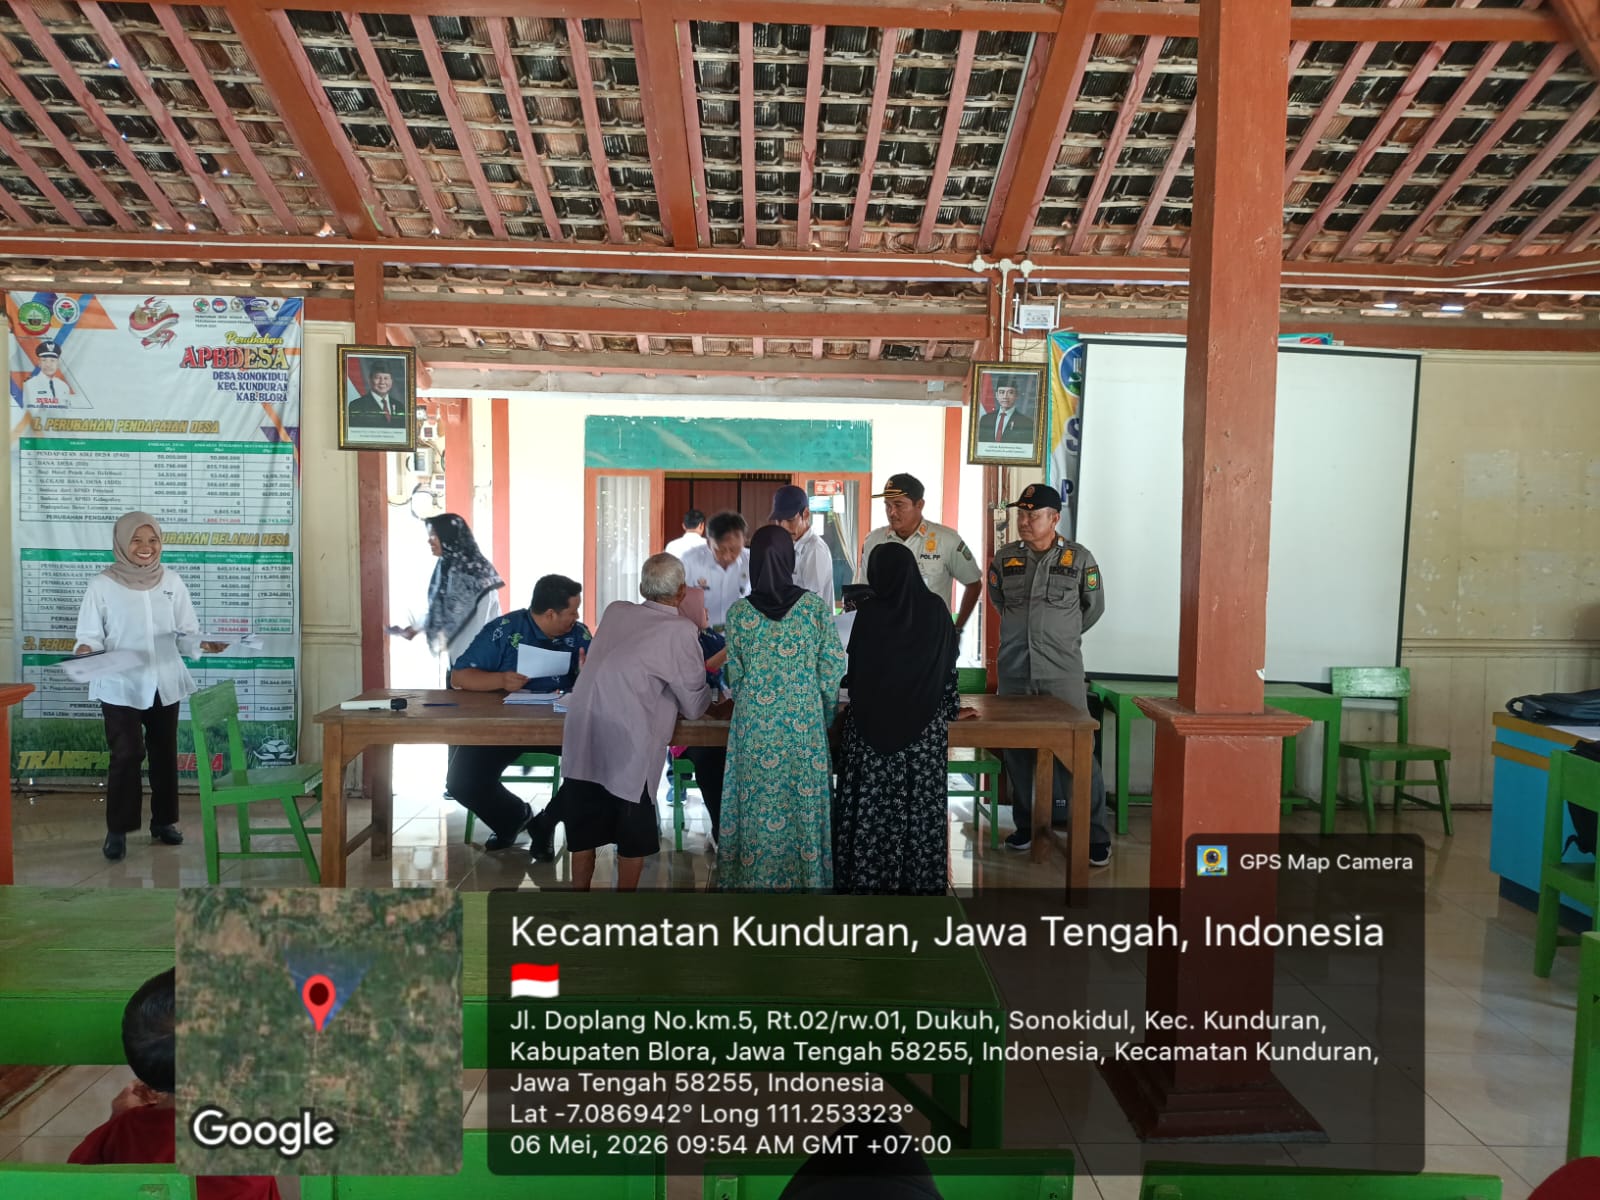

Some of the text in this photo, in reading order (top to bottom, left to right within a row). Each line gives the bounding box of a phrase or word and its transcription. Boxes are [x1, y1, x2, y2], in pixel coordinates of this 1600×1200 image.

[225, 331, 284, 345] Perubahan
[180, 346, 290, 369] APBDESA
[213, 371, 288, 382] DESA SONOKIDUL
[217, 381, 288, 391] KEC. KUNDURAN
[259, 392, 287, 402] BLORA
[45, 417, 115, 431] PERUBAHAN
[116, 419, 189, 433] PENDAPATAN
[190, 420, 219, 433] DESA
[211, 532, 260, 545] BELANJA
[261, 533, 289, 546] DESA
